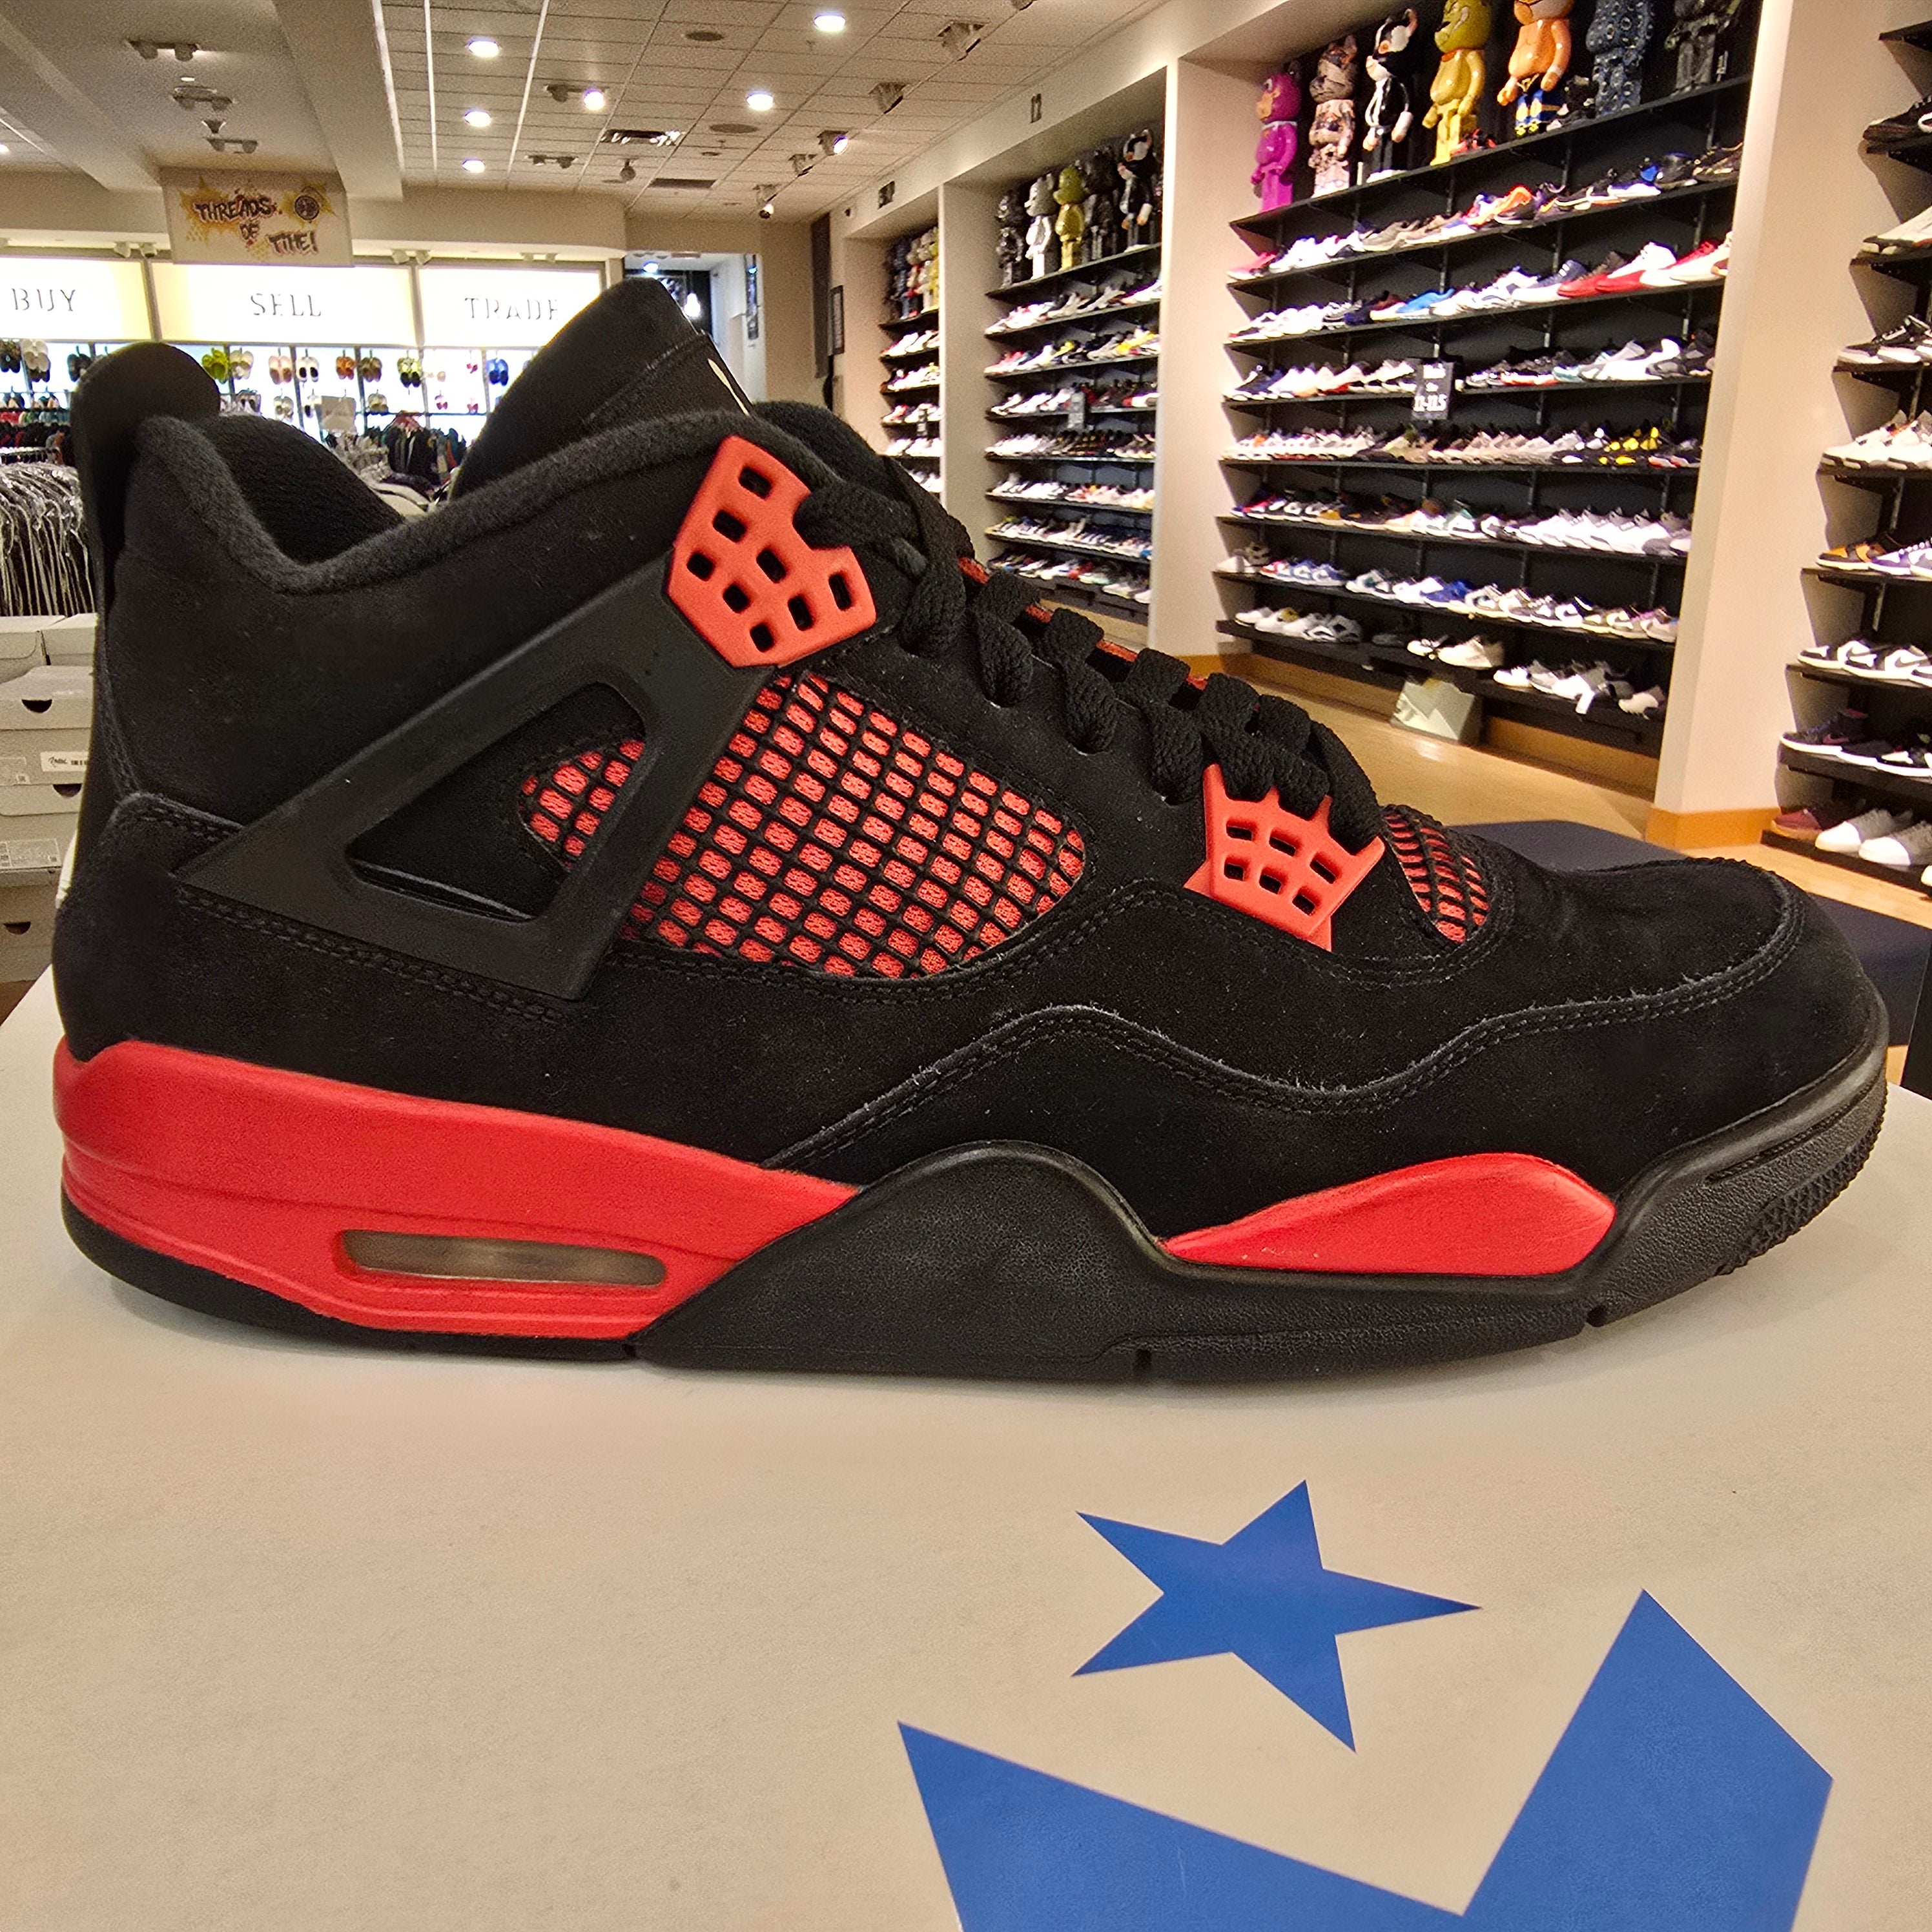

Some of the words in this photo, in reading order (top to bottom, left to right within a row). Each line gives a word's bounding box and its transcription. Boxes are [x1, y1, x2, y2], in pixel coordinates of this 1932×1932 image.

[194, 196, 273, 221] THREADS
[239, 223, 260, 241] OF
[12, 288, 76, 312] BUY
[251, 293, 322, 317] SELL
[464, 297, 559, 321] TRADE
